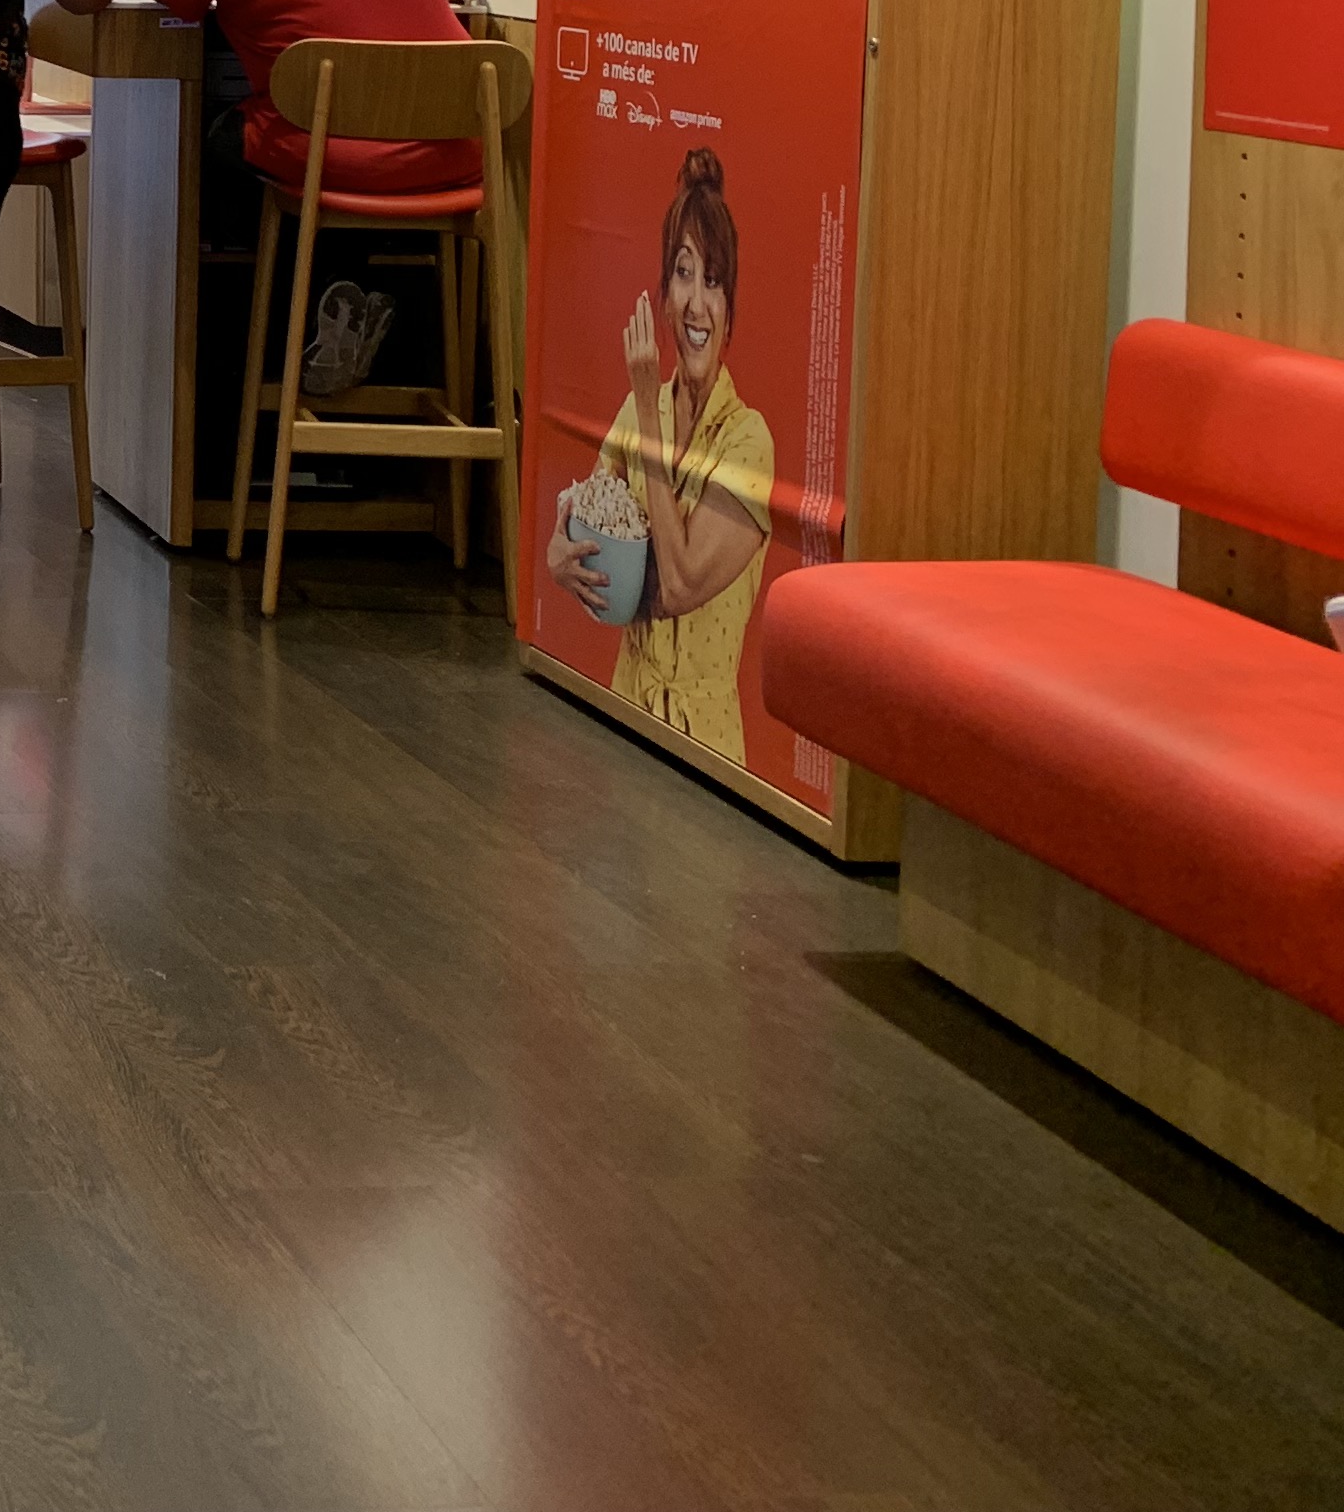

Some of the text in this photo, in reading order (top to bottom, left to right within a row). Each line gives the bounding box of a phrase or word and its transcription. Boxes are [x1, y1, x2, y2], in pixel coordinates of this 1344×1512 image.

[596, 31, 699, 65] +100 canals de TV
[602, 62, 609, 77] a
[611, 60, 636, 82] més
